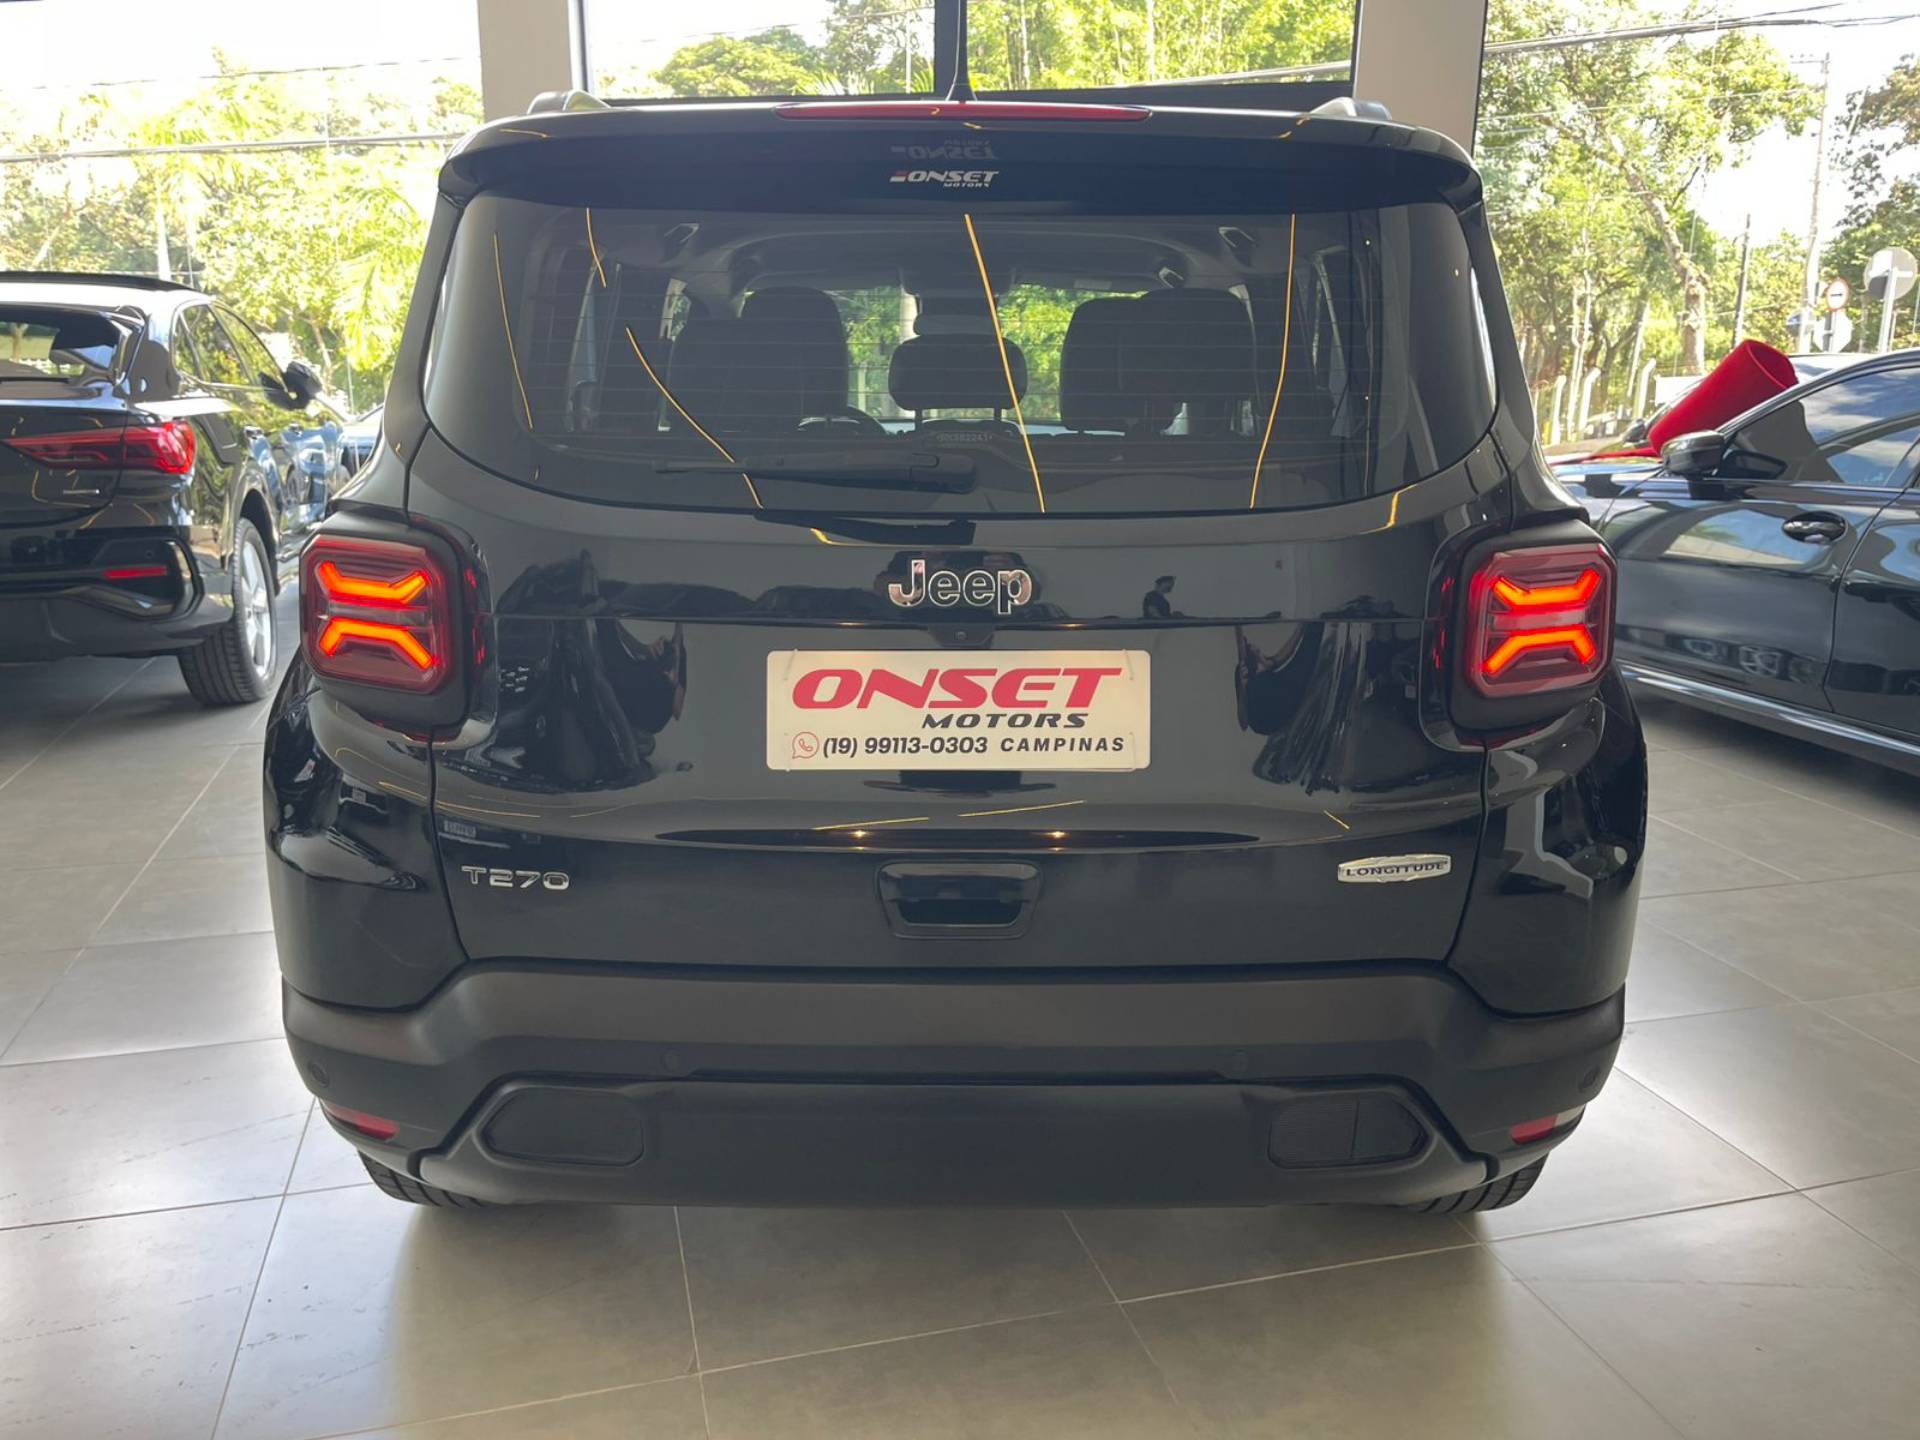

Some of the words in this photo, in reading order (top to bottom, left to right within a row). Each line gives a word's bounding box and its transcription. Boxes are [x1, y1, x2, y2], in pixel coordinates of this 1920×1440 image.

[908, 170, 999, 182] ONSET
[888, 559, 1032, 614] Jeep
[792, 668, 1122, 709] ONSET
[921, 713, 1089, 729] MOTORS
[823, 736, 858, 758] (19)
[864, 736, 988, 754] 99113-0303
[1000, 737, 1124, 752] CAMPINAS
[461, 865, 569, 891] T270
[1346, 861, 1447, 877] LONGITUDE
